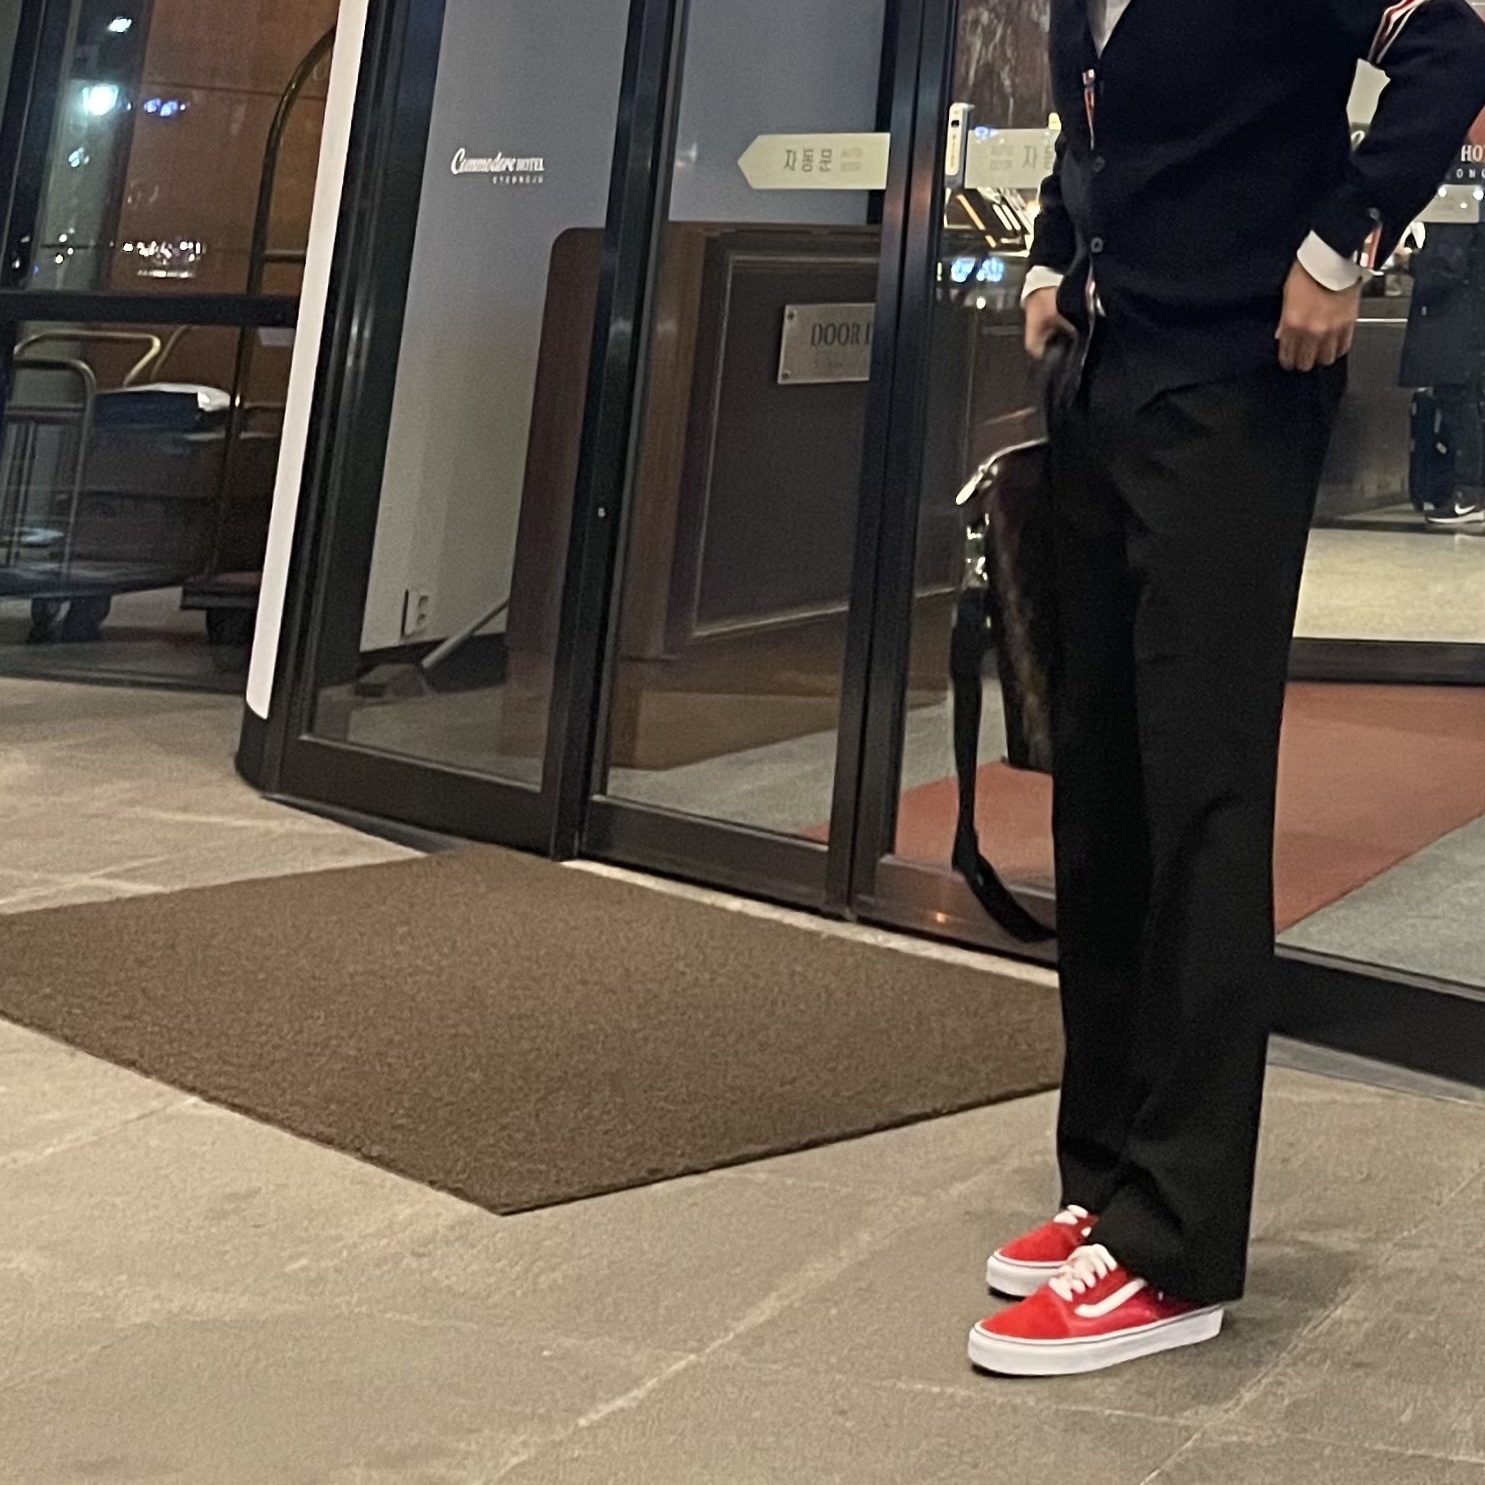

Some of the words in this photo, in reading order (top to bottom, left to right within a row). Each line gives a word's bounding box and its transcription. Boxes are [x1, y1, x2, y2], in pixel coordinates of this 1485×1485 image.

[516, 157, 545, 171] HOTEL
[783, 147, 833, 173] 자동문
[810, 321, 860, 346] DOOR
